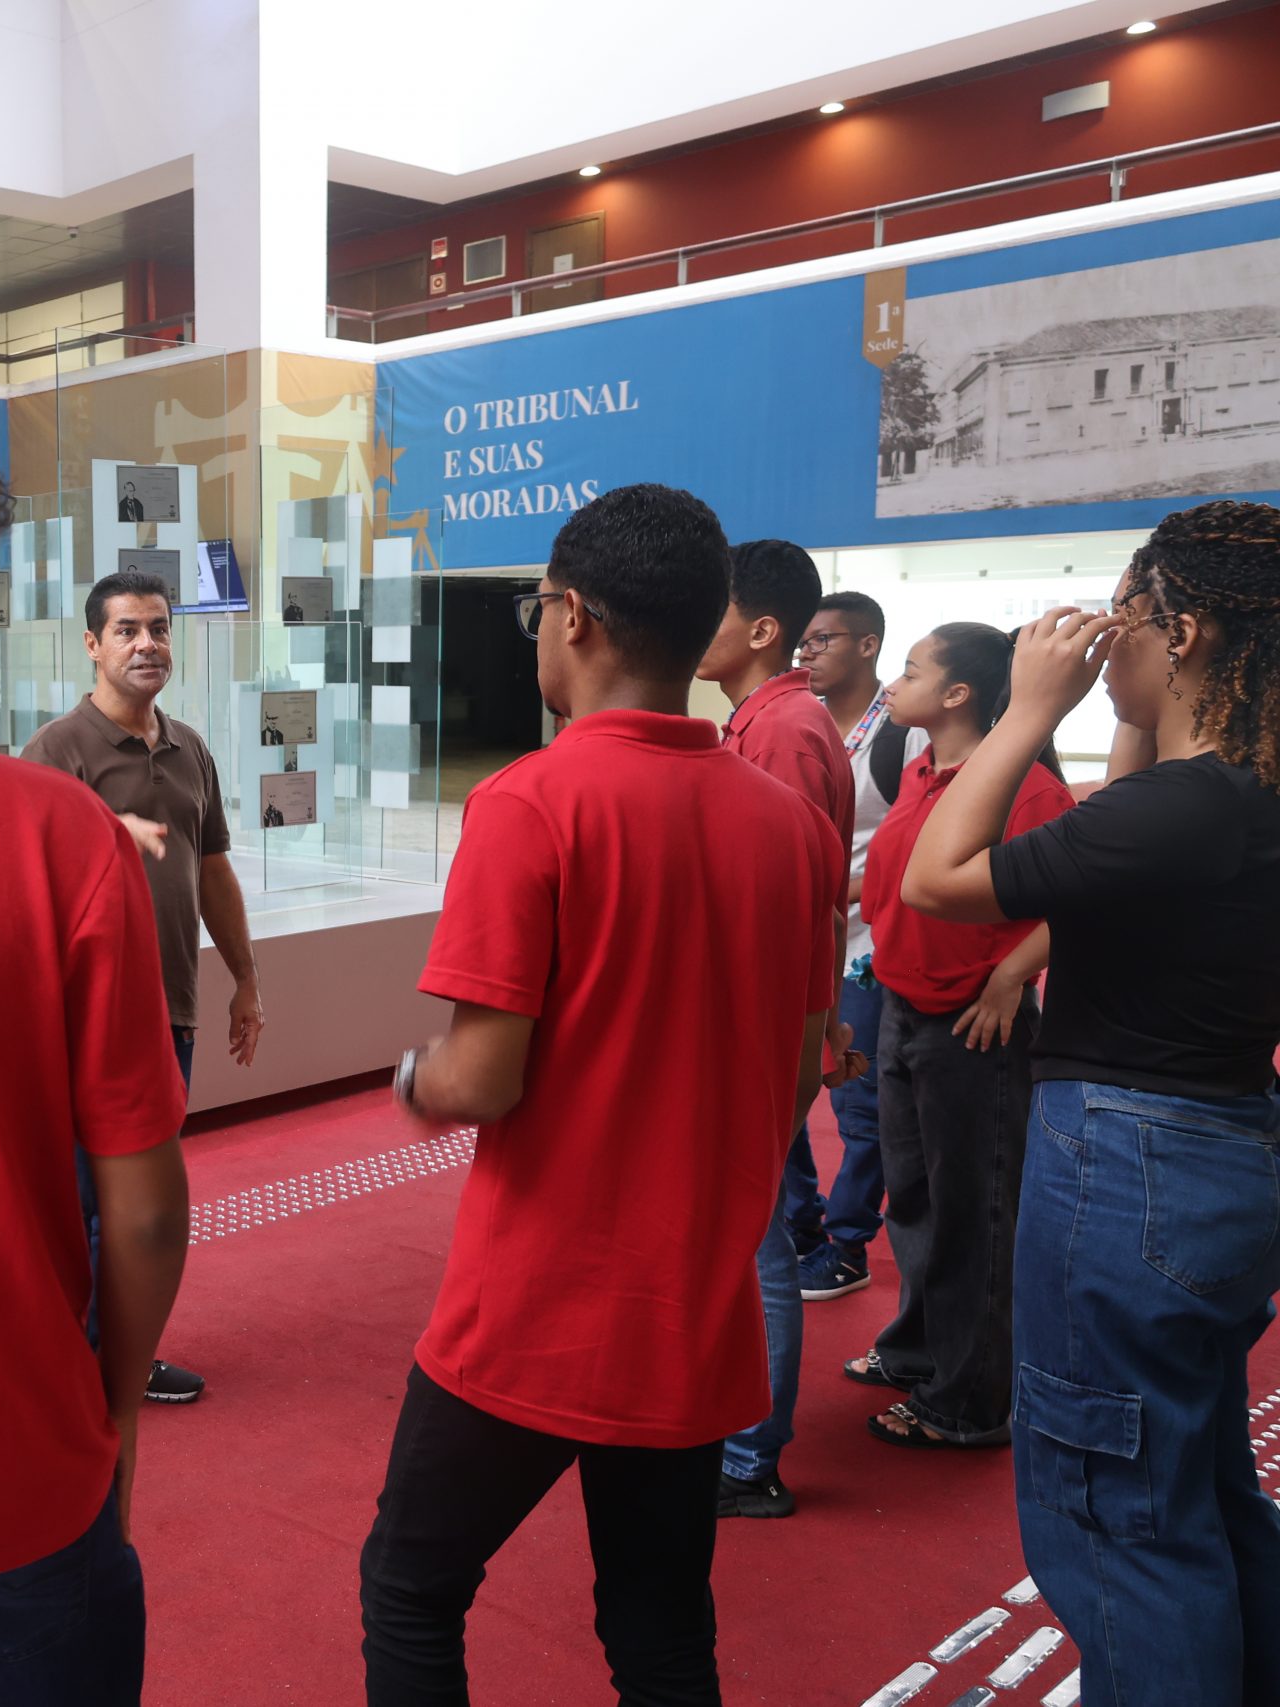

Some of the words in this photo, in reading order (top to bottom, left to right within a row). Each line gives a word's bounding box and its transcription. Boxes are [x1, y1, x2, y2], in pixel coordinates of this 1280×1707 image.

[867, 338, 898, 352] Sede
[443, 405, 467, 435] O
[474, 380, 639, 432] TRIBUNAL
[443, 450, 462, 479] E
[468, 439, 544, 476] SUAS
